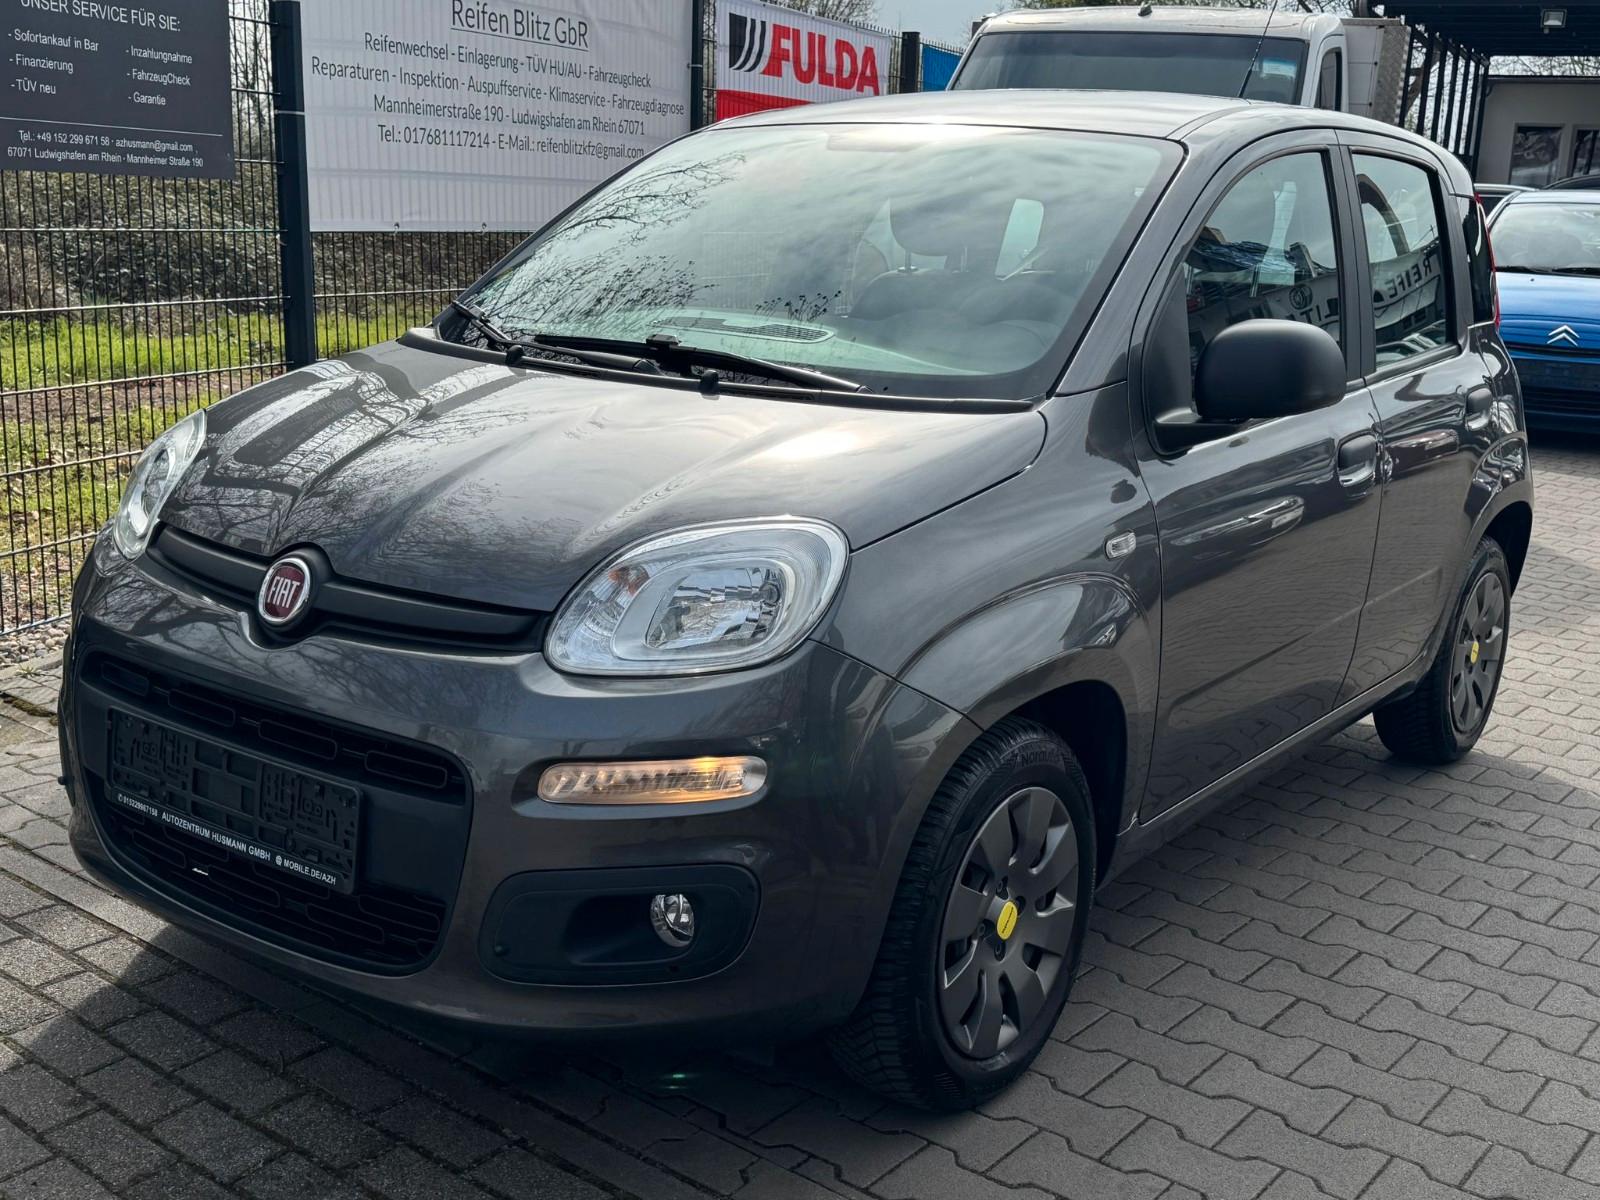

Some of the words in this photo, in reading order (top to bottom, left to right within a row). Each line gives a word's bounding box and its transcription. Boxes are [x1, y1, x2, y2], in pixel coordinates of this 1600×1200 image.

[72, 0, 128, 23] SERVICE
[131, 8, 156, 28] FÜR
[159, 14, 181, 32] SIE:
[452, 0, 509, 34] Reifen
[514, 9, 551, 41] Blitz
[554, 17, 589, 48] GbR
[14, 29, 71, 48] Sofortankauf
[74, 36, 82, 49] in
[84, 38, 99, 52] Bar
[131, 45, 192, 64] Inzahlungnahme
[15, 54, 74, 74] Finanzierung
[365, 32, 449, 61] Reifenwechsel
[458, 45, 519, 73] Einlagerung
[526, 54, 548, 74] TÜV
[550, 59, 582, 79] HU/AU
[589, 65, 651, 89] Fahrzeugcheck
[760, 24, 880, 96] FULDA
[16, 78, 37, 92] TÜV
[39, 82, 56, 94] neu
[132, 69, 190, 87] FahrzeugCheck
[311, 56, 390, 82] Reparaturen
[399, 67, 459, 91] Inspektion
[467, 75, 543, 100] Auspuffservice
[550, 86, 605, 107] Klimaservice
[612, 94, 684, 116] Fahrzeugdiagnose
[133, 92, 166, 106] Garantie
[374, 94, 481, 120] Mannheimerstraße
[484, 105, 503, 123] 190
[512, 108, 575, 130] Ludwigshafen
[577, 118, 591, 131] am
[592, 115, 617, 133] Rhein
[618, 119, 645, 135] 67071
[7, 146, 32, 158] 67071
[34, 147, 86, 162] Ludwigshafen
[88, 151, 100, 161] am
[101, 151, 122, 163] Rhein
[126, 153, 167, 165] Mannheimer
[169, 155, 190, 167] Straße
[191, 156, 204, 168] 190
[18, 130, 35, 142] Tel.:
[37, 131, 52, 143] +49
[53, 132, 68, 144] 152
[69, 133, 84, 144] 299
[85, 134, 99, 145] 671
[100, 135, 110, 146] 58
[115, 138, 193, 153] azhusmann@gmail.com
[378, 124, 401, 143] Tel.:
[404, 126, 490, 148] 017681117214
[536, 138, 644, 160] reifenblitzkfz@gmail.com
[267, 575, 301, 609] FIAT
[161, 811, 210, 838] AUTOZENTRUM
[211, 831, 247, 853] HUSMANN
[248, 845, 271, 861] GMBH
[283, 858, 337, 885] MOBILE.DE/AZH
